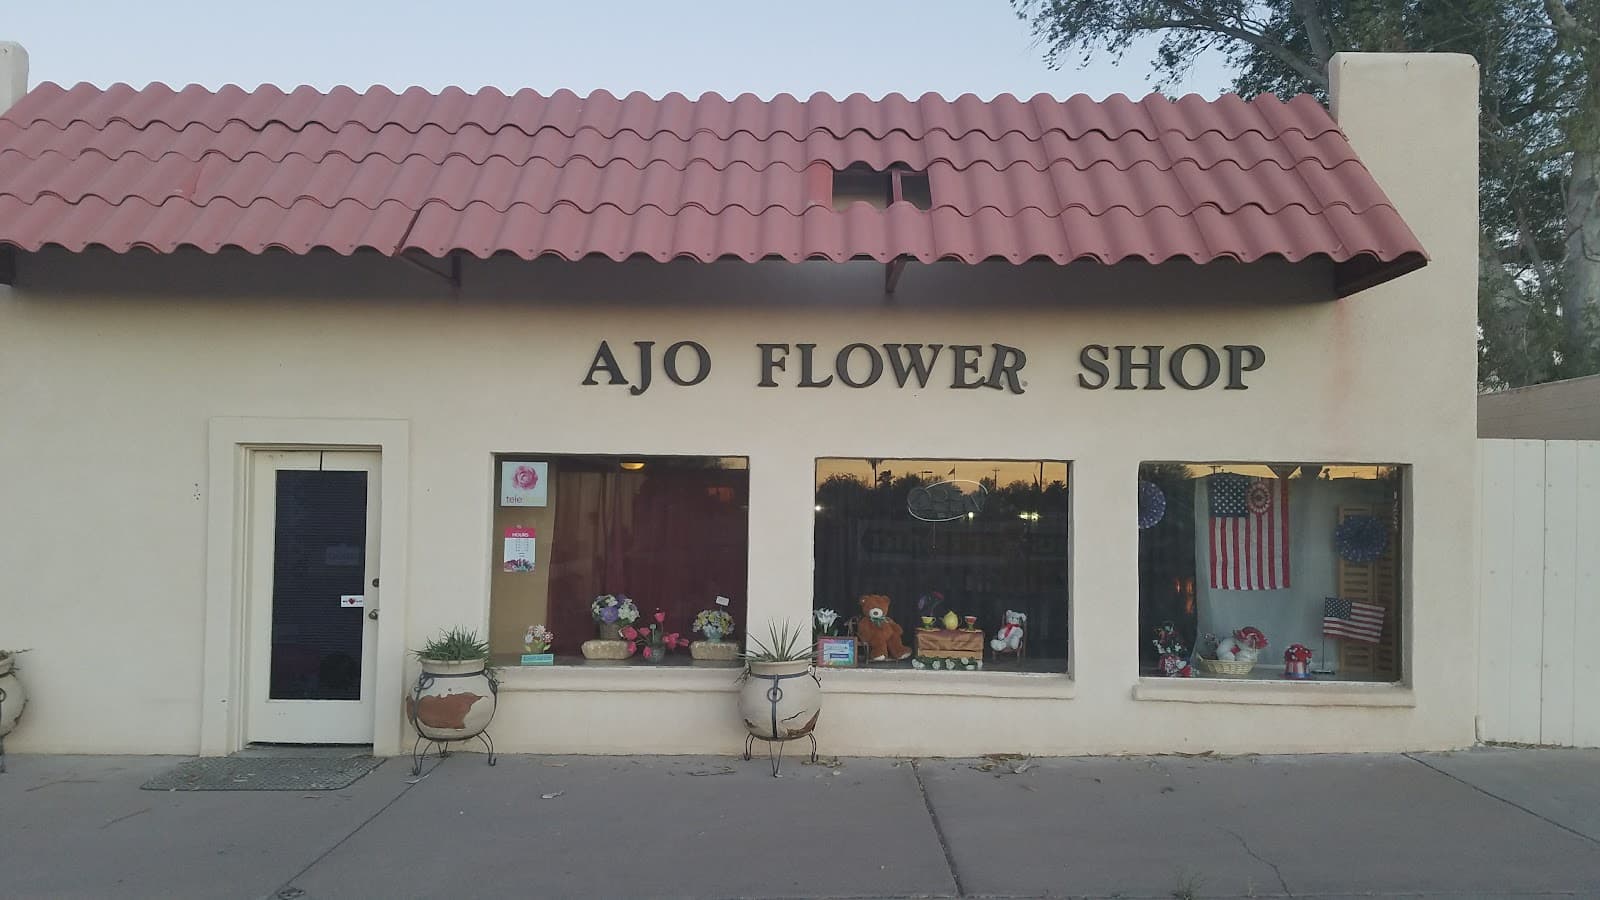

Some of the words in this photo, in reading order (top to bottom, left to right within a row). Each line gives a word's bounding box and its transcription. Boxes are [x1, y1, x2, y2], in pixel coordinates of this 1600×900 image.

[582, 340, 711, 395] AJO
[757, 343, 1027, 394] FLOWER
[1078, 343, 1266, 390] SHOP
